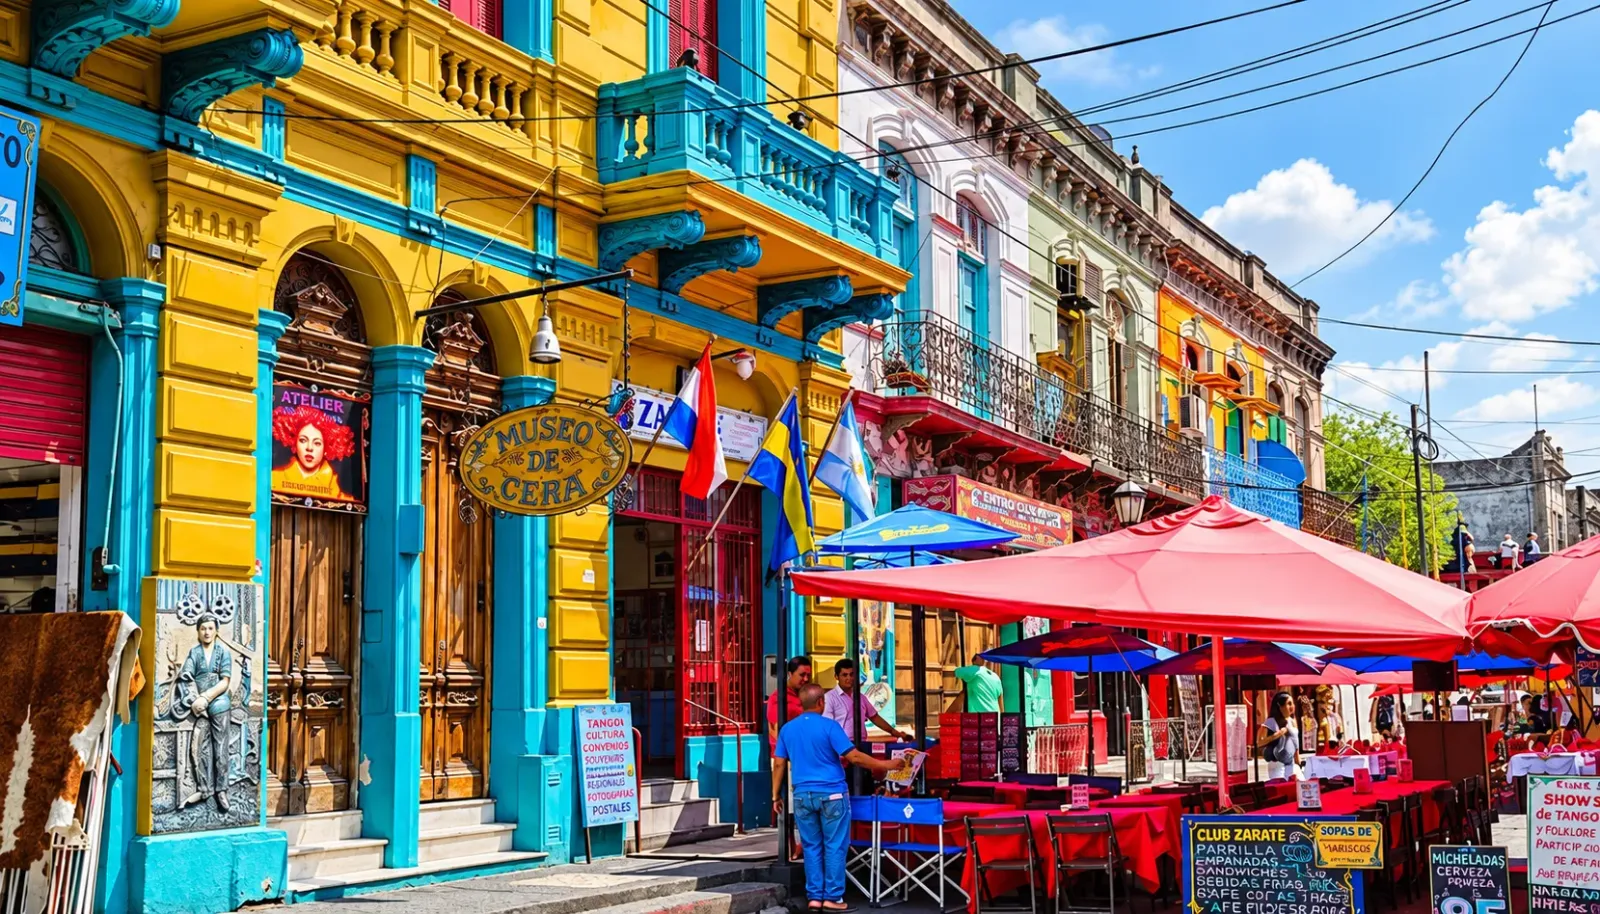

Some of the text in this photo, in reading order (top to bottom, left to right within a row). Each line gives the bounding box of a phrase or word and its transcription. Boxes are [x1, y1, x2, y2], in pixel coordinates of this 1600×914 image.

[281, 390, 344, 413] ATELIER
[495, 416, 594, 454] MUSEO
[527, 449, 559, 472] DE
[501, 472, 588, 506] CERA
[586, 730, 625, 740] CULTURA
[593, 801, 632, 816] POSTALES
[1536, 807, 1600, 822] de TANGO
[1197, 828, 1286, 842] CLUB ZARATE
[1321, 826, 1372, 836] SOPAS DE
[1545, 825, 1597, 838] FOLKLORE
[1195, 844, 1276, 856] PARRILLA
[1195, 856, 1279, 868] EMPANADAS
[1553, 855, 1567, 865] DE
[1437, 866, 1492, 877] CERVEZA
